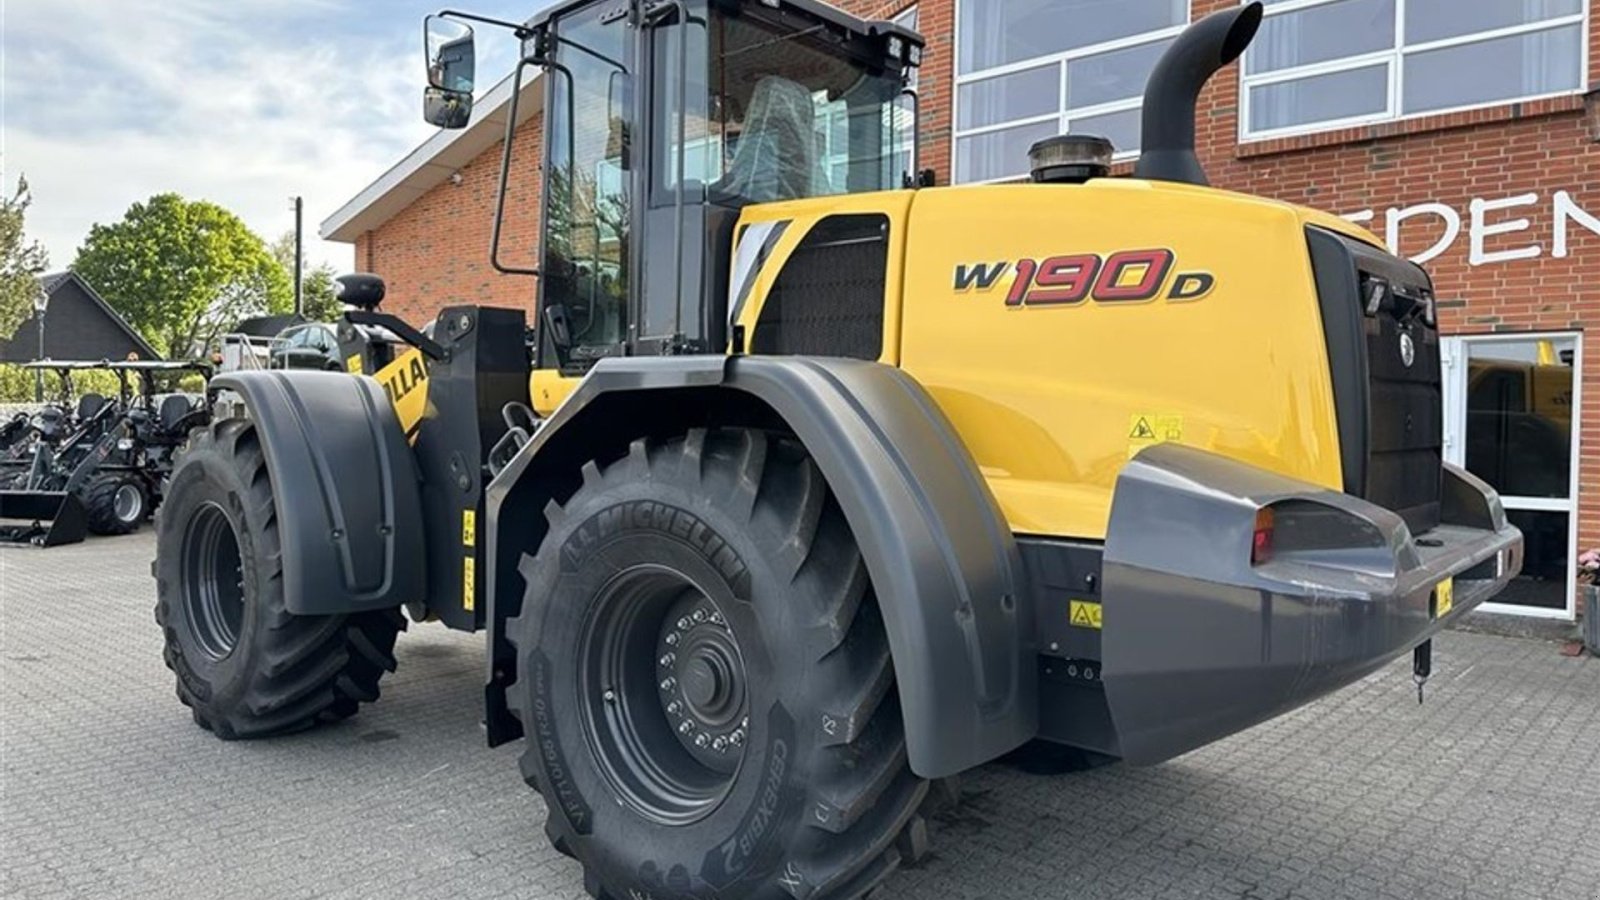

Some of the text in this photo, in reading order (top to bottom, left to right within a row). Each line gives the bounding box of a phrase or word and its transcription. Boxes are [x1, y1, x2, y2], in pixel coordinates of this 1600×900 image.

[1338, 189, 1600, 266] DEN
[598, 501, 748, 582] MICHELIN
[721, 738, 787, 875] CEREXBIB 2
